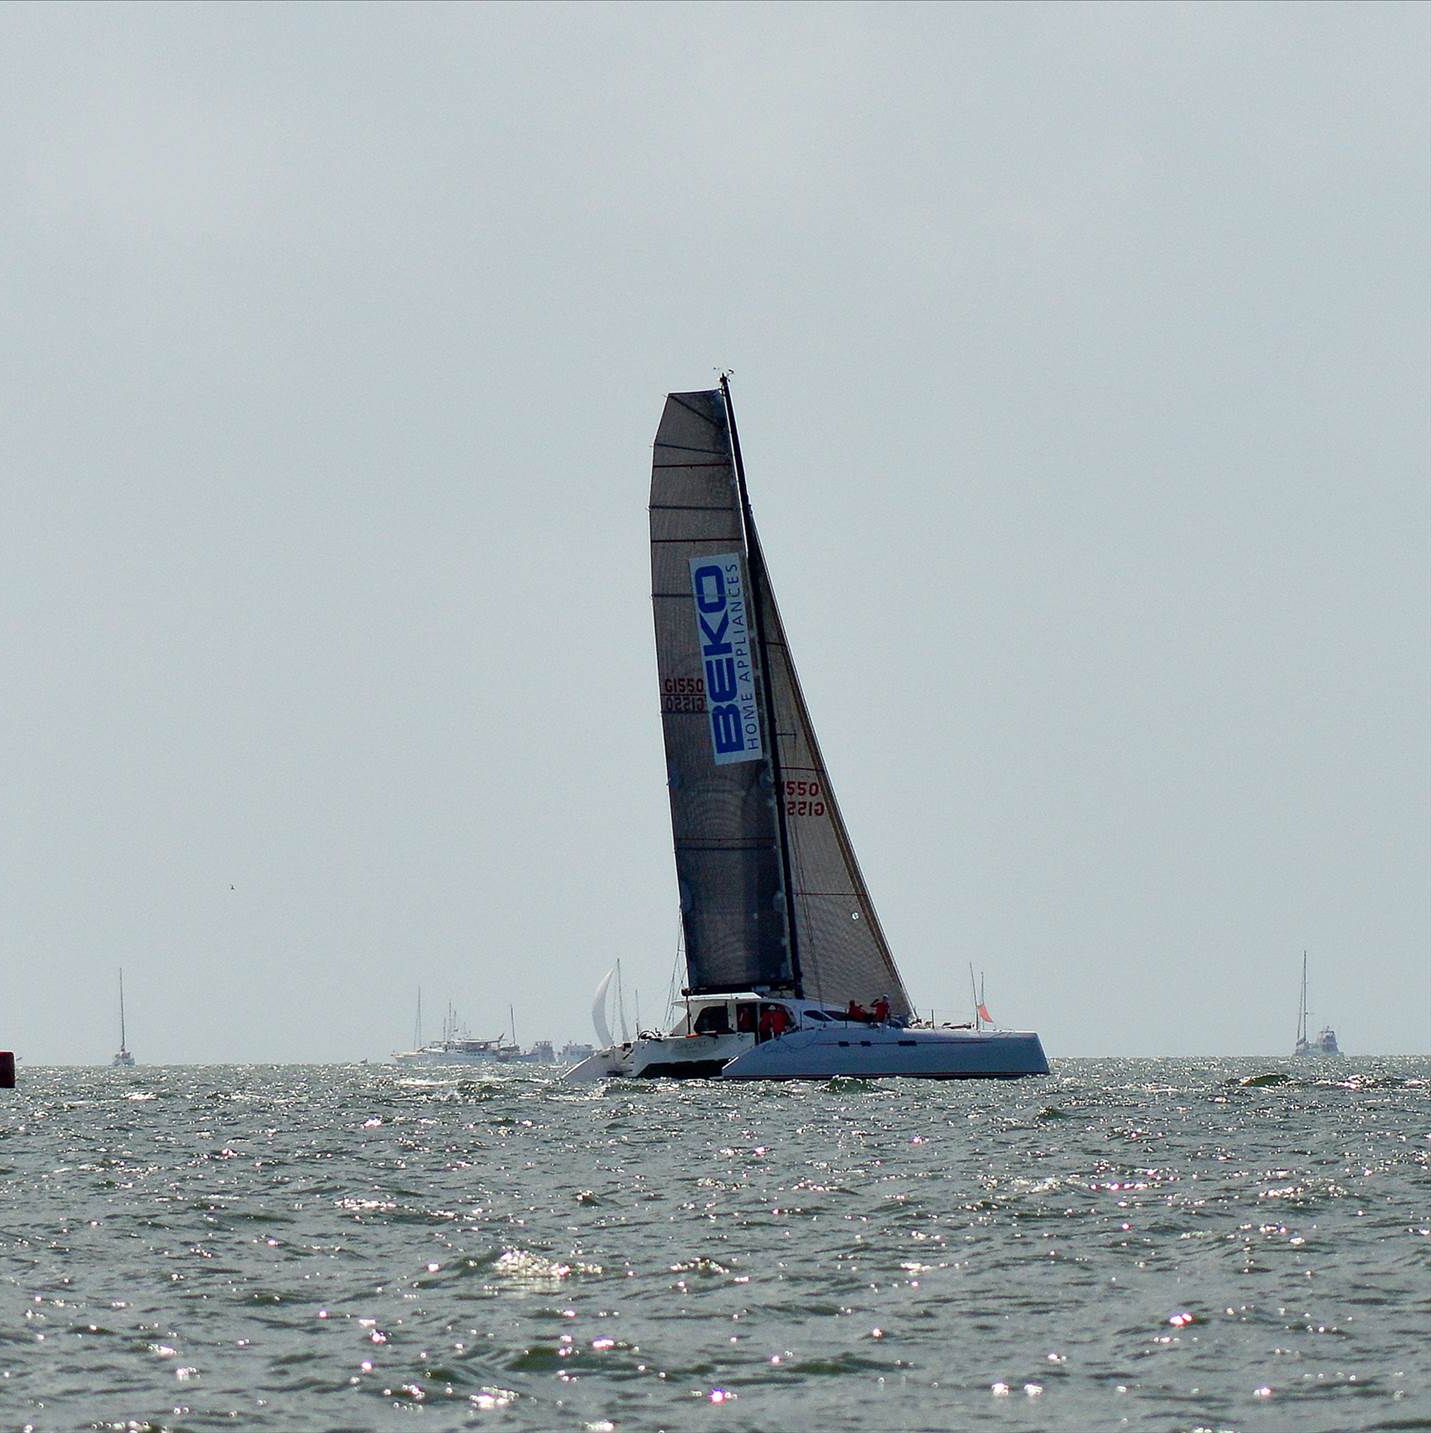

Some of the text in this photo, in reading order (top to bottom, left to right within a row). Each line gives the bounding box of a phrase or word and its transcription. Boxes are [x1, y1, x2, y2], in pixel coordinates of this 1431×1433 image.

[694, 565, 745, 754] BEKO
[725, 563, 759, 750] HOME APPLIANCES
